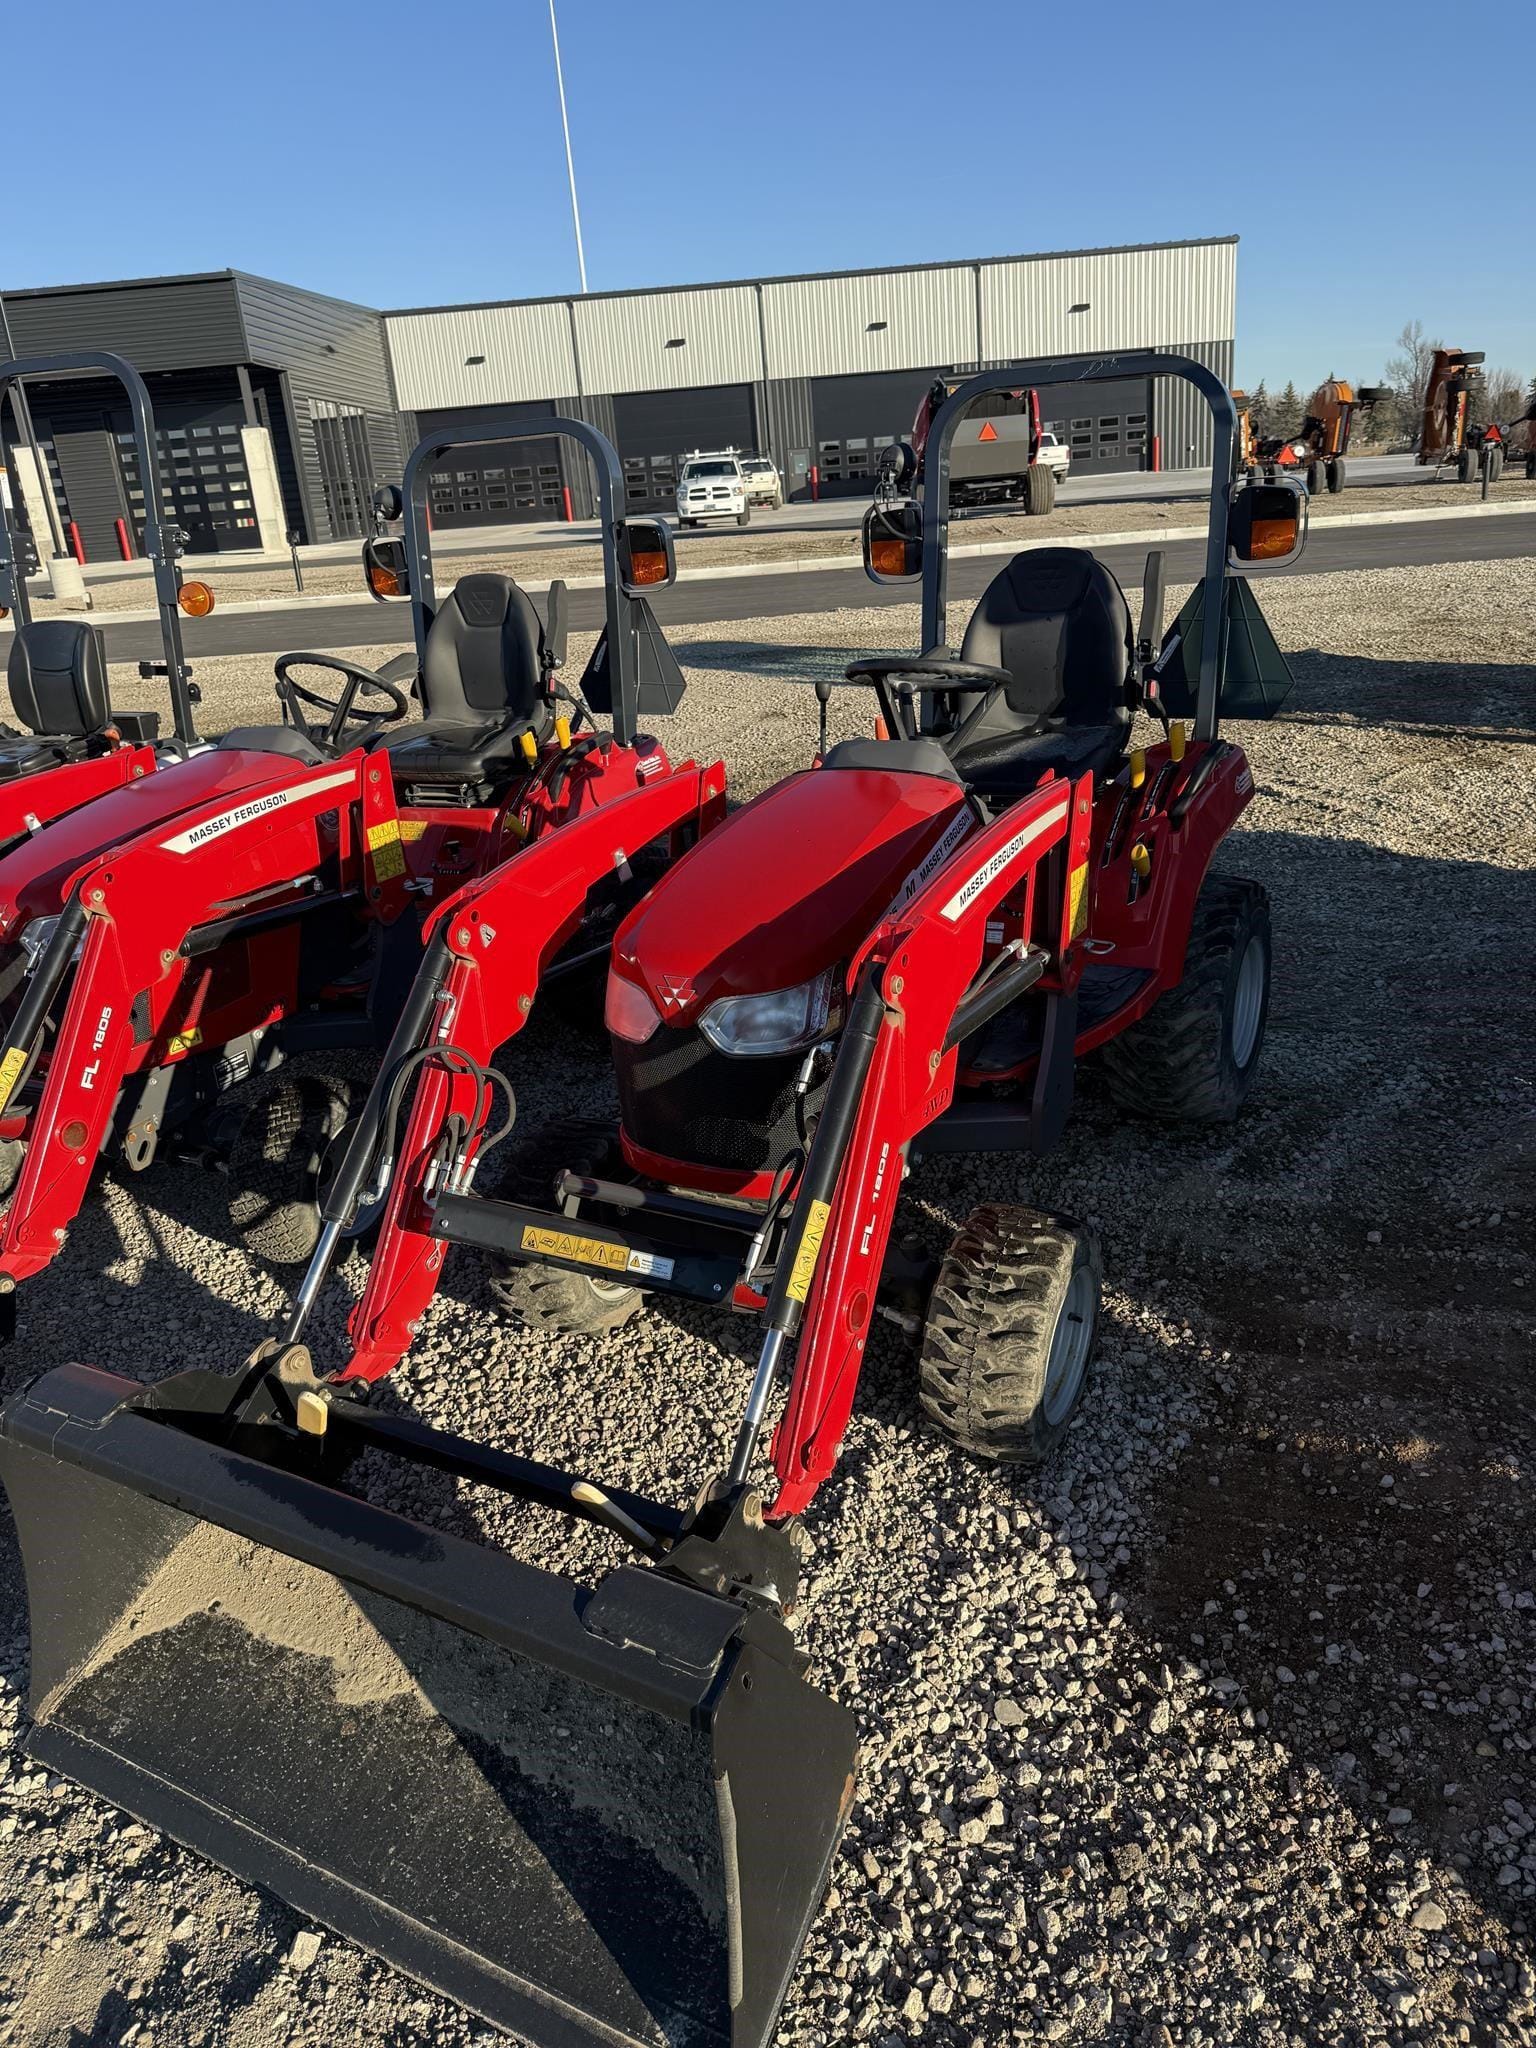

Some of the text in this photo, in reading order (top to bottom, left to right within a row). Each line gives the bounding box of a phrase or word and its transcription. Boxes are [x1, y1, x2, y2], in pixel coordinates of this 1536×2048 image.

[189, 793, 288, 844] MASSEY FERGUSON
[920, 847, 944, 882] MASSEY
[943, 811, 970, 851] FERGUSON
[959, 834, 1024, 908] MASSEY FERGUSON
[80, 1006, 113, 1090] FL 1805
[860, 1142, 890, 1256] FL 1805
